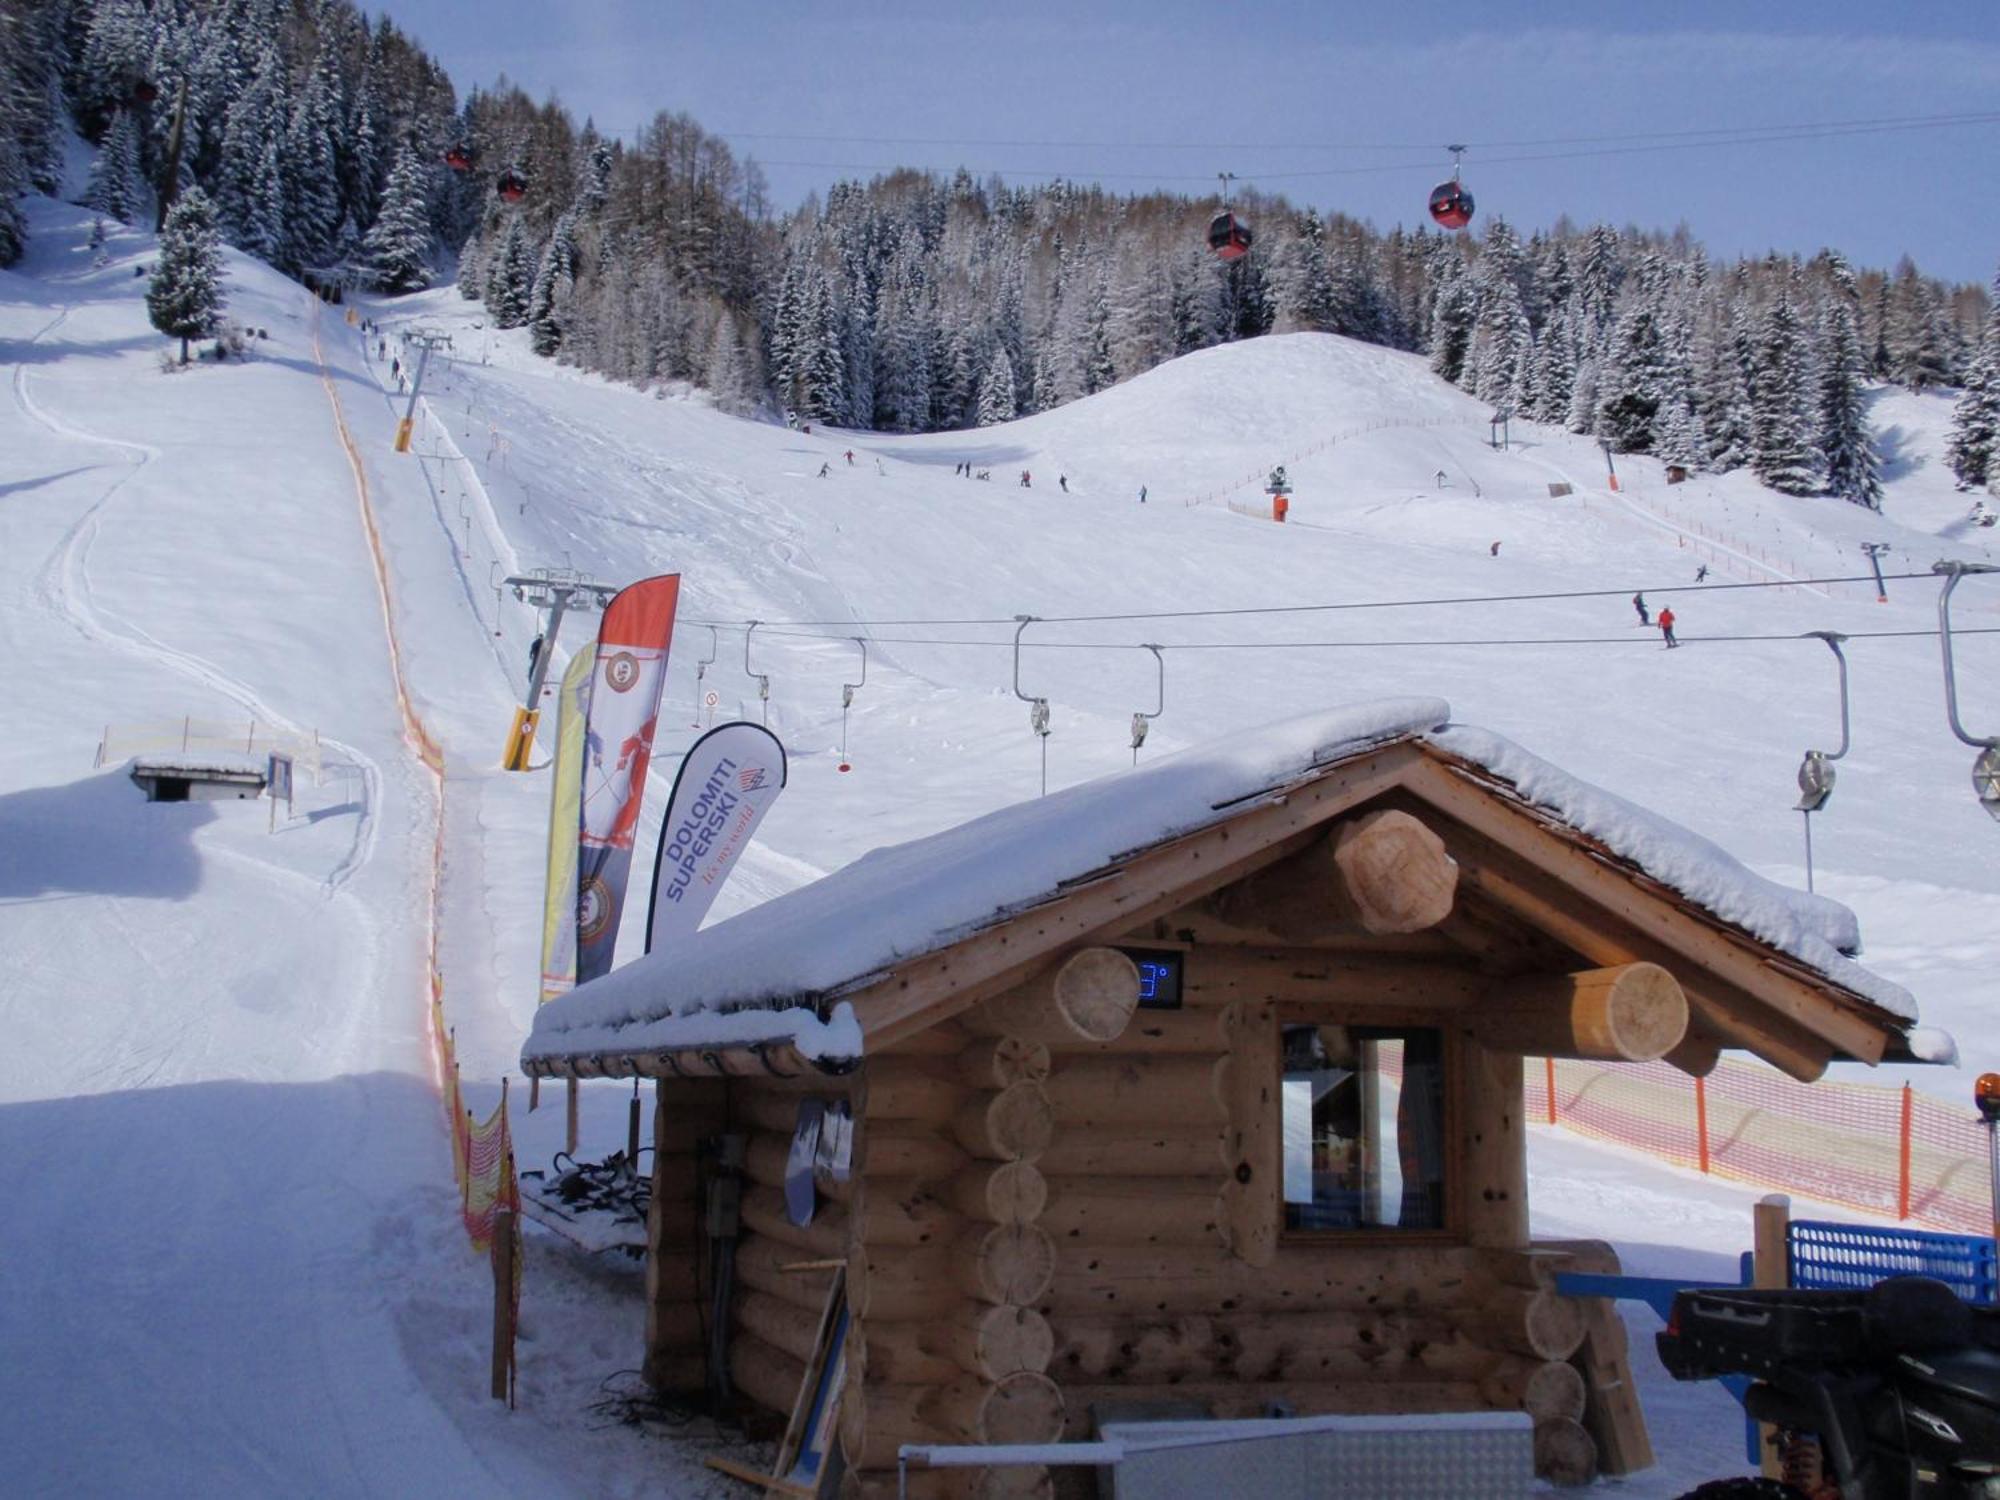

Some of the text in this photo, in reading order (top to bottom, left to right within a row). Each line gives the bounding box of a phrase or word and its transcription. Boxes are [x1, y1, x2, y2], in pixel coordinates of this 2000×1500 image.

[666, 758, 737, 862] DOLOMITI
[667, 792, 738, 902] SUPERSKI
[717, 844, 733, 865] my
[731, 804, 754, 843] world
